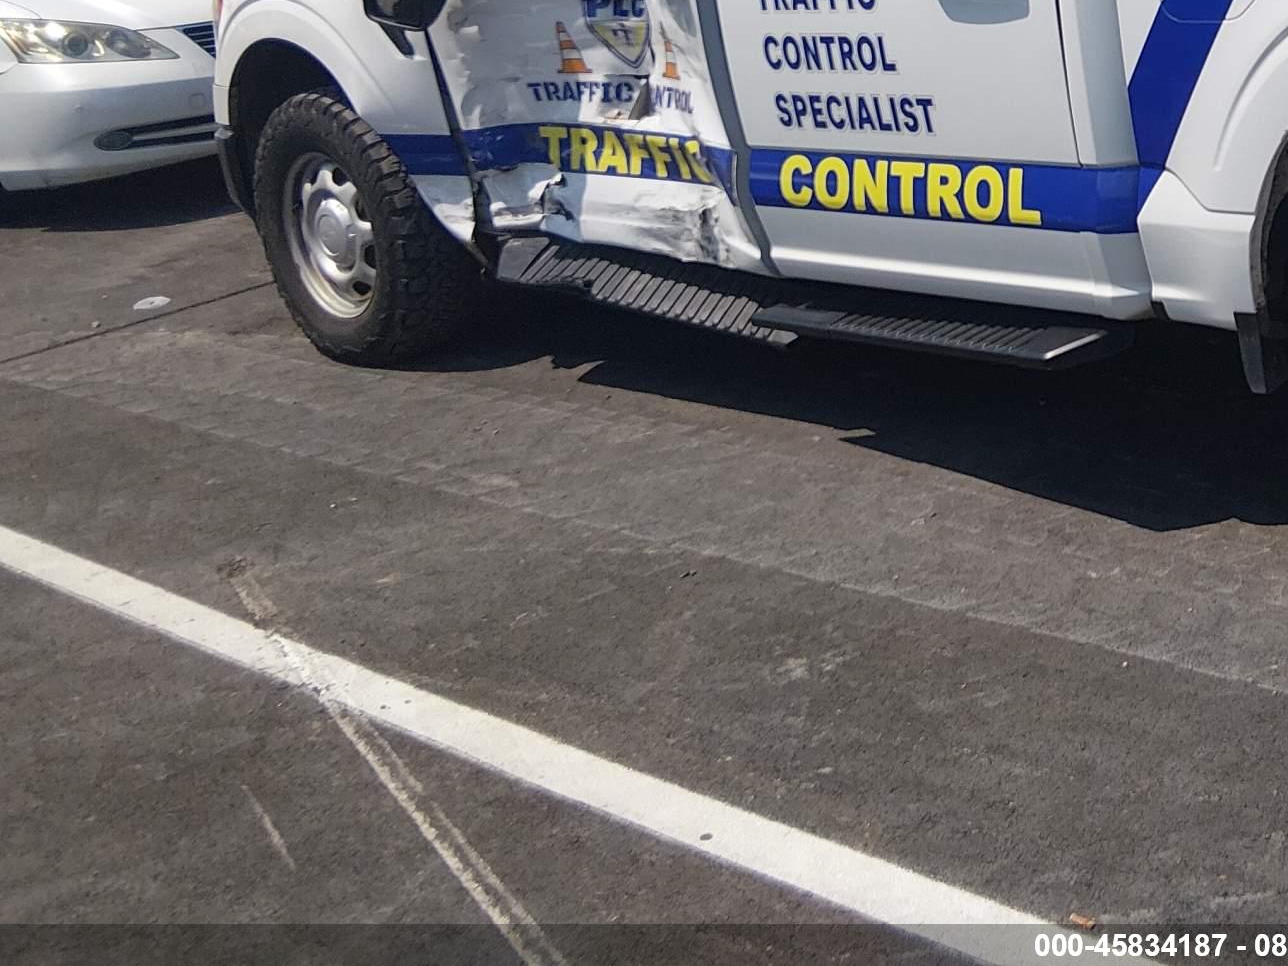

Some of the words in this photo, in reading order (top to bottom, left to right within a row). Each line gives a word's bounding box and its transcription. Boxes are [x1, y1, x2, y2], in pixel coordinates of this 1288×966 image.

[763, 35, 897, 72] CONTROL
[528, 80, 634, 106] TRAFFIC
[775, 93, 934, 133] SPECIALIST
[538, 125, 714, 185] TRAFFIC
[780, 154, 1042, 225] CONTROL
